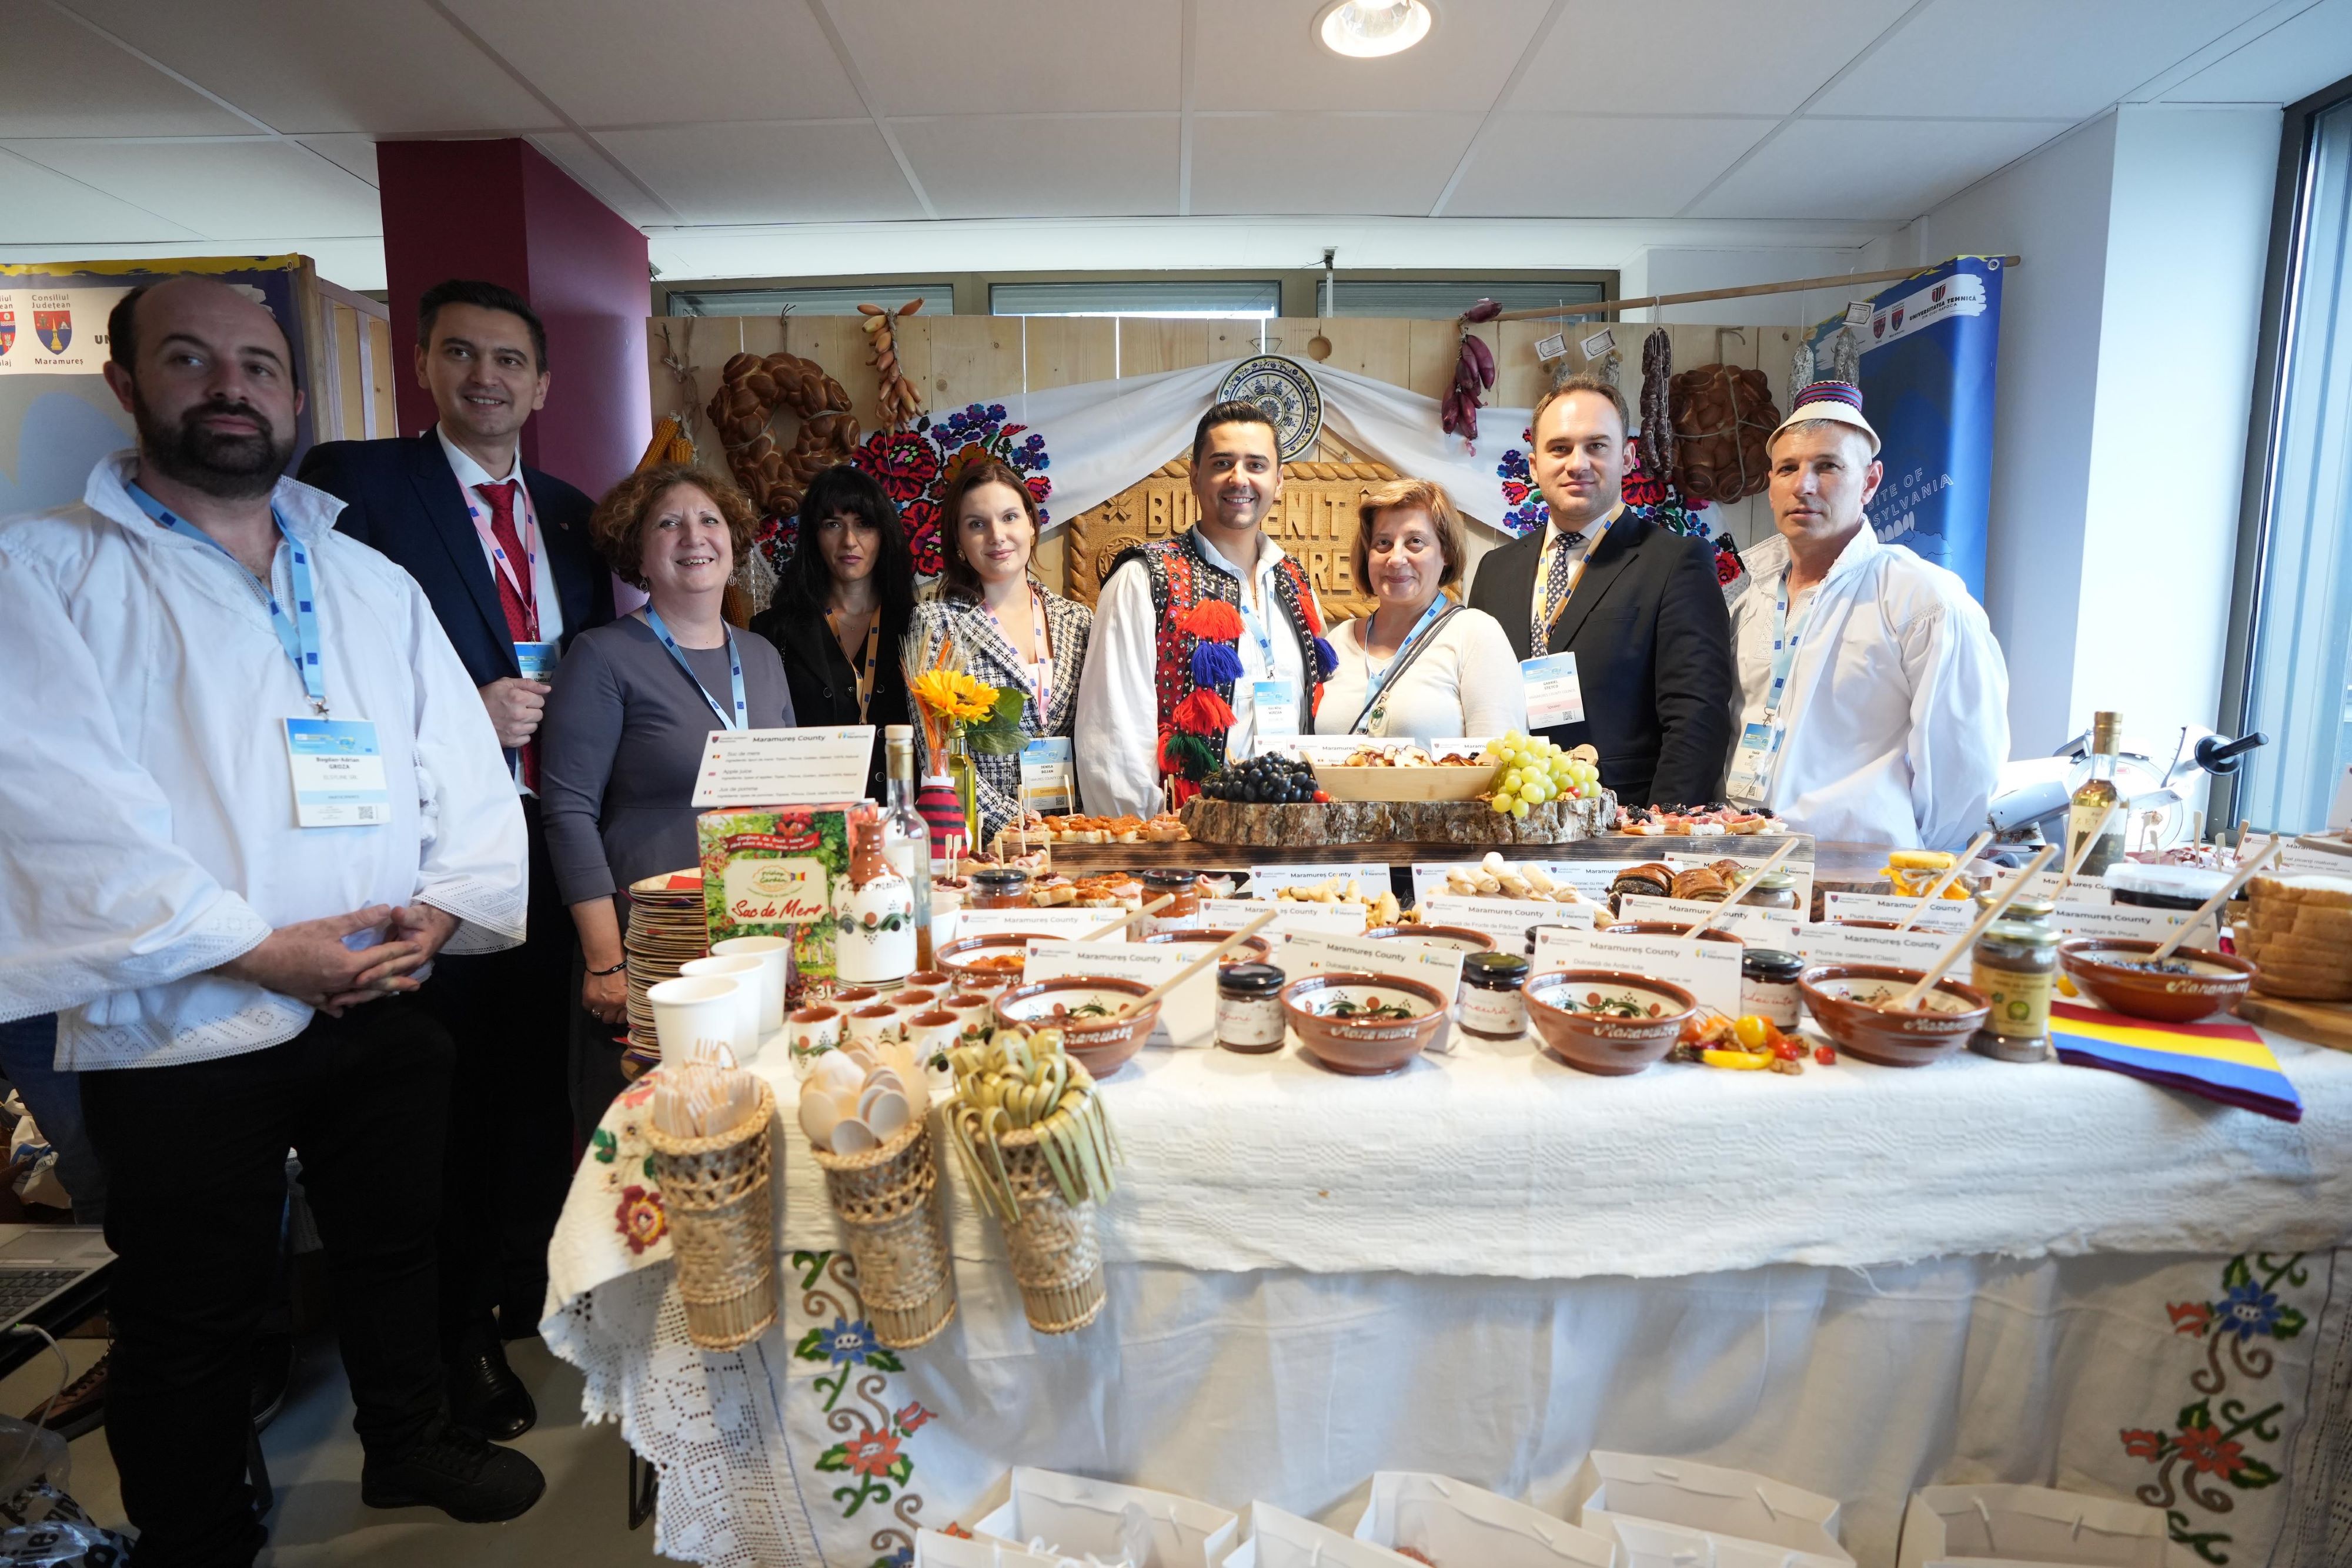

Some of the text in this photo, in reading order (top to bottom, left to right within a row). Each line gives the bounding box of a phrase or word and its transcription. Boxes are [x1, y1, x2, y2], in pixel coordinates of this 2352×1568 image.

[1909, 301, 1945, 321] UNIVERSITATEA
[1904, 467, 1923, 488] OF
[1869, 473, 1954, 527] SYLVANIA
[760, 901, 777, 917] de
[1468, 907, 1544, 918] Maramureș County
[1929, 904, 1963, 913] County
[2056, 910, 2151, 925] Maramureș County
[1589, 942, 1681, 958] Maramureș County
[1845, 934, 1941, 951] Maramureș County
[1077, 952, 1127, 962] Maramureș
[1130, 955, 1161, 963] County
[1327, 944, 1406, 962] Maramureș County
